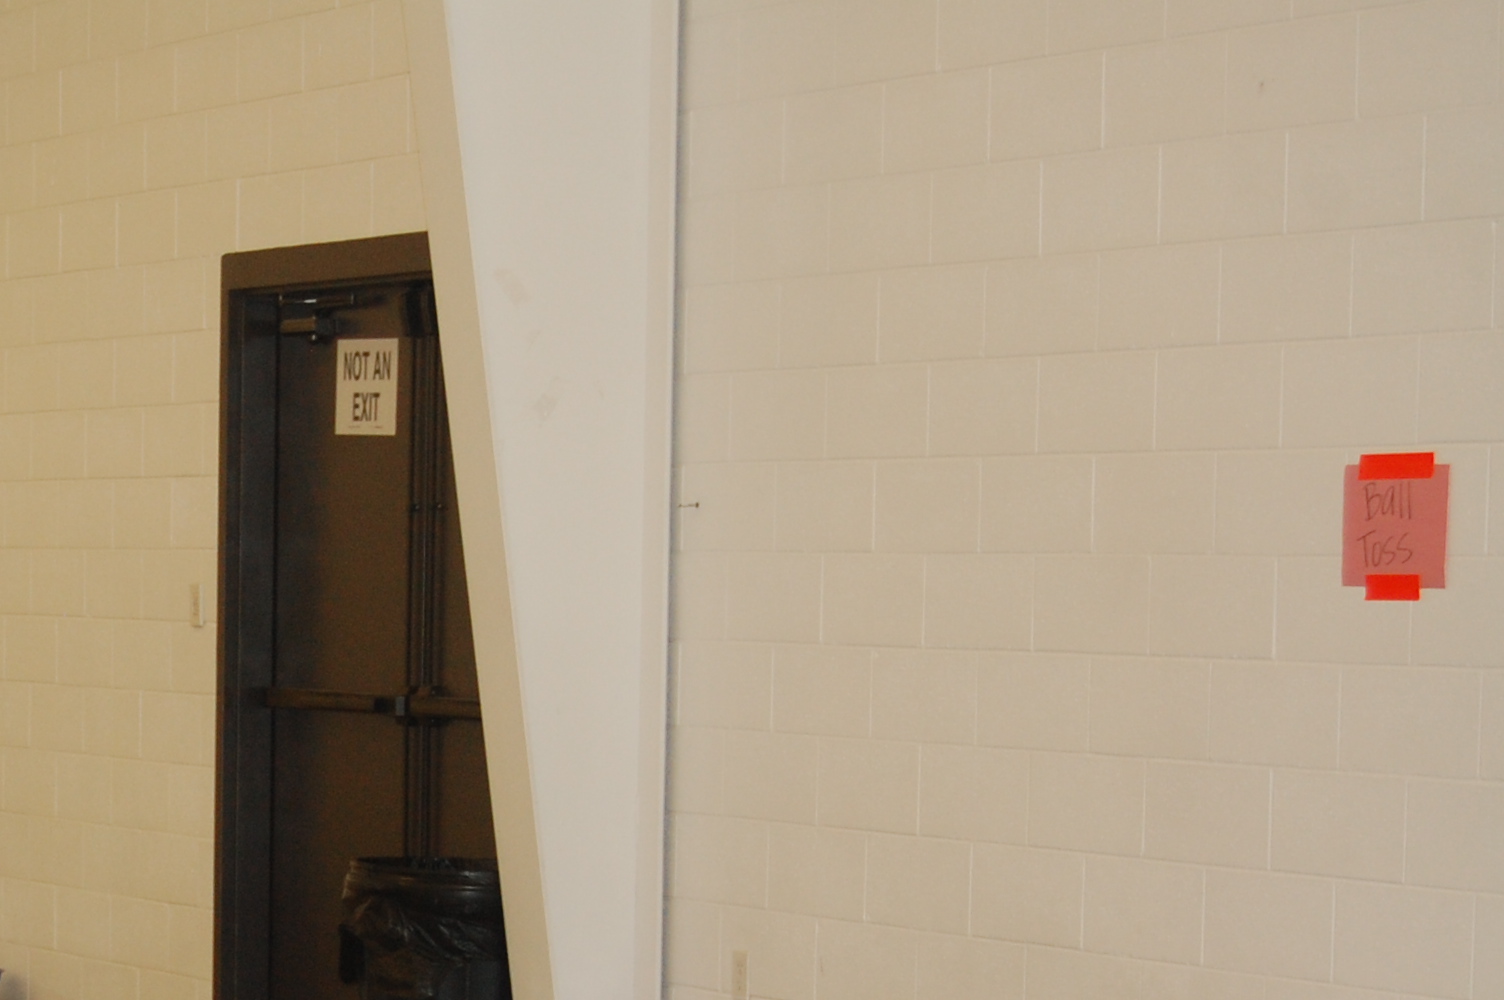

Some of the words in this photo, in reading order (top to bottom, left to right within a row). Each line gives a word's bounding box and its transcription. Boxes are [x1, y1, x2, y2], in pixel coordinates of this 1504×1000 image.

[343, 351, 370, 381] NOT
[373, 350, 392, 380] AN
[352, 392, 380, 422] EXIT
[1364, 480, 1412, 521] Ball
[1357, 529, 1414, 568] Toss
